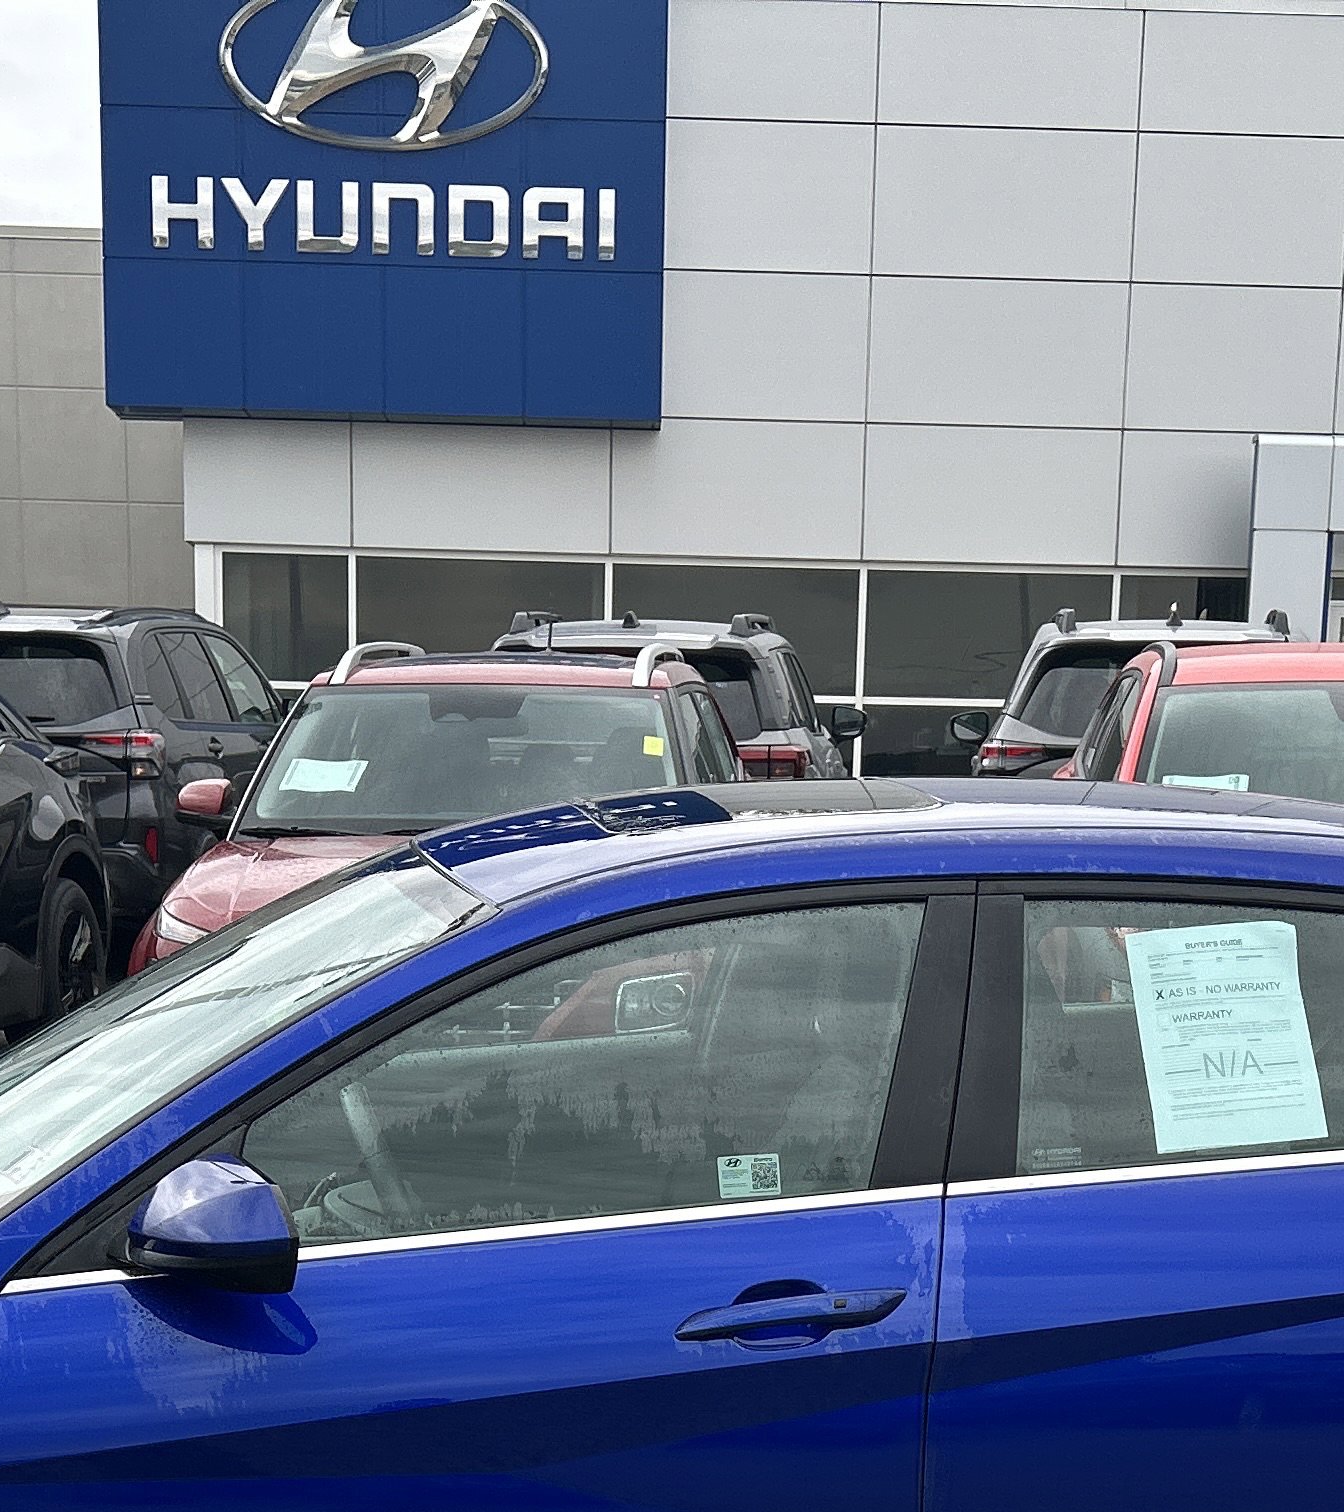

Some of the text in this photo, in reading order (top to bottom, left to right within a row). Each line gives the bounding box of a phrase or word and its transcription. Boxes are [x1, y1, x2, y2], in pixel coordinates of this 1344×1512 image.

[151, 175, 616, 261] HYUNDAI
[1168, 988, 1184, 998] AS
[1186, 986, 1197, 996] IS
[1205, 985, 1222, 994] NO
[1224, 981, 1281, 993] WARRANTY
[1172, 1009, 1233, 1024] WARRANTY
[1202, 1049, 1264, 1078] N/A
